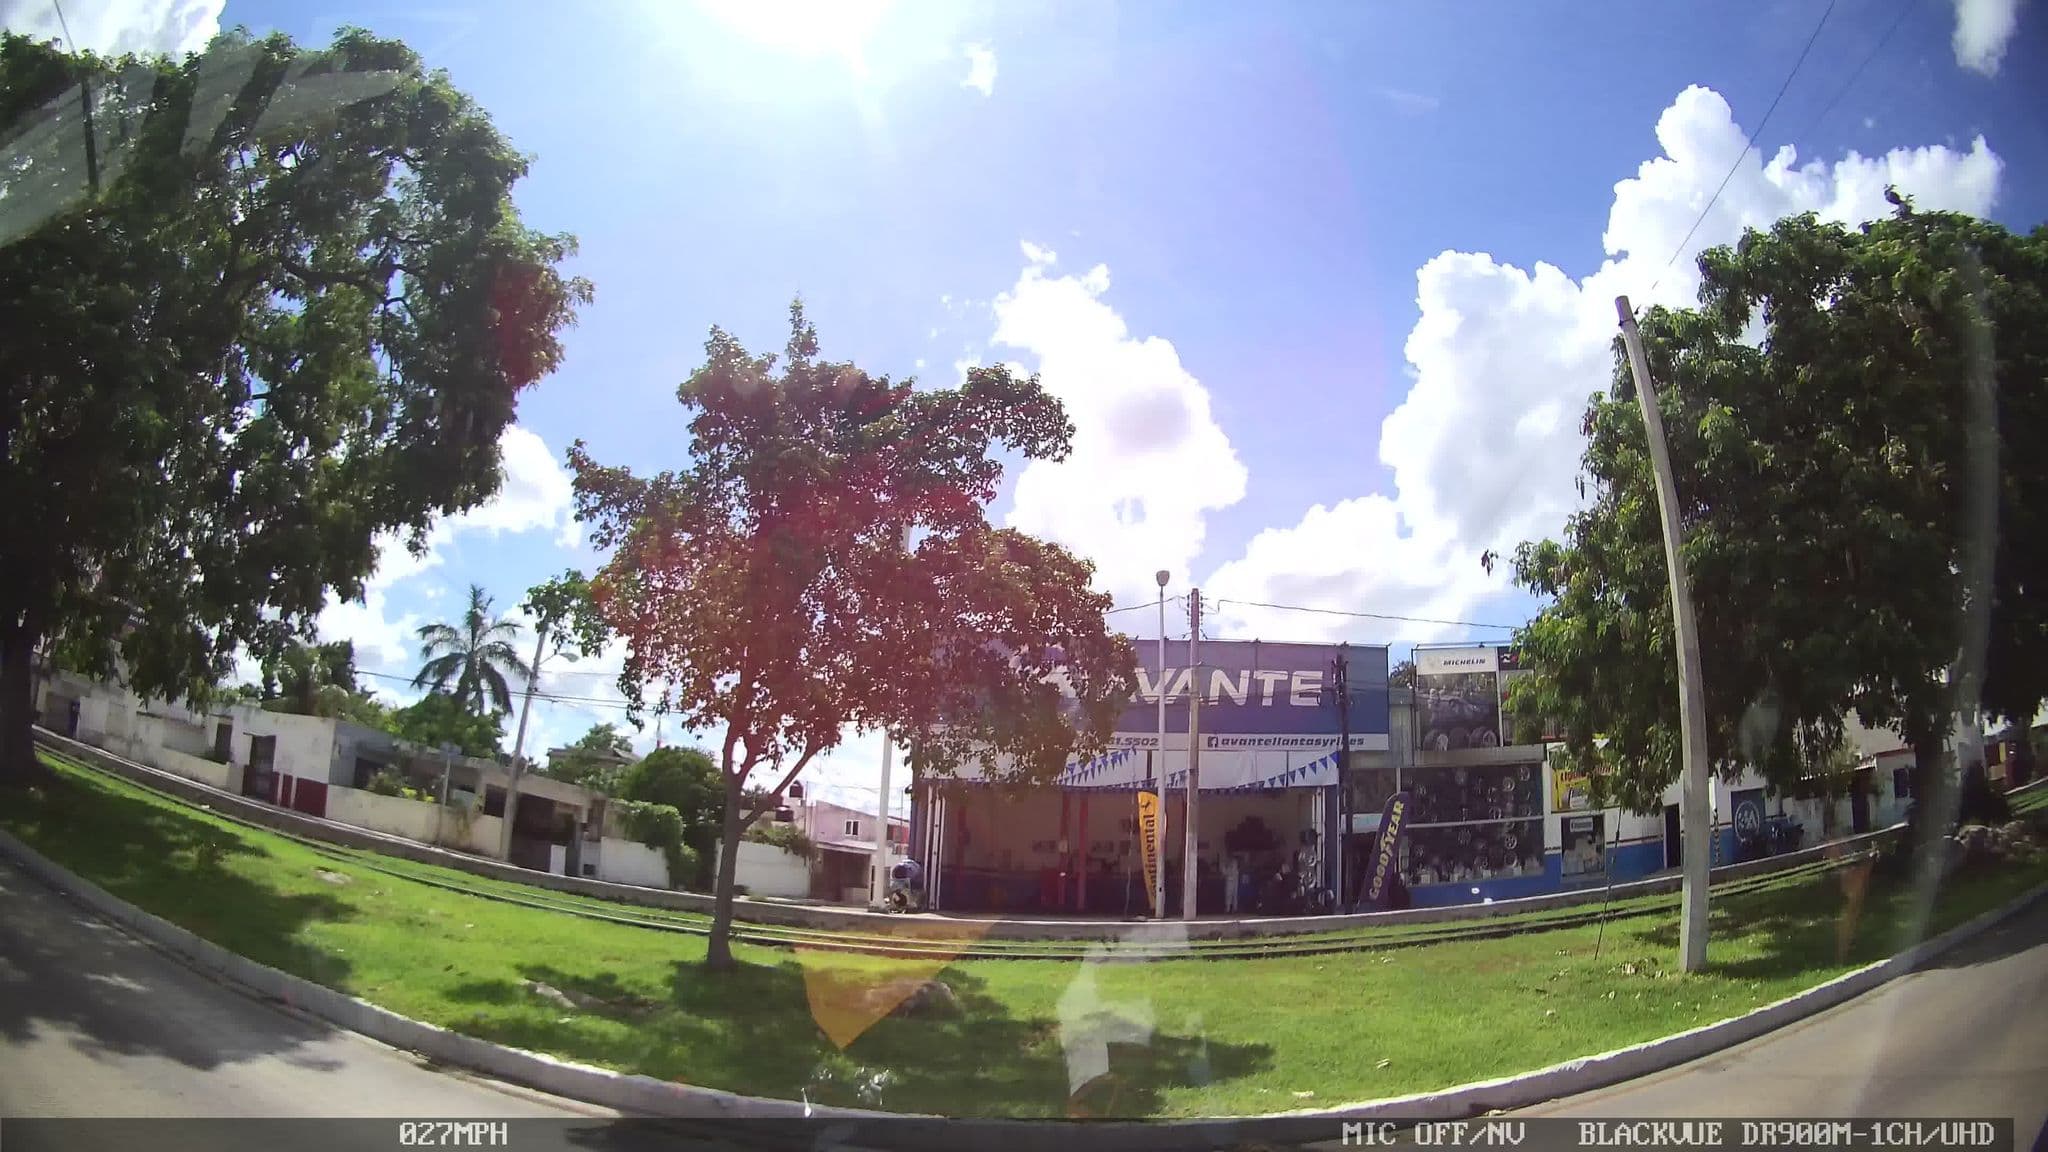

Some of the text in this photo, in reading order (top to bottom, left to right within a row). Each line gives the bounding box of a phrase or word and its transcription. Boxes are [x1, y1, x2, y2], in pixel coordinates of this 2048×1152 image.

[1443, 658, 1486, 666] MICHELIN
[1129, 666, 1323, 706] VANTE
[1221, 736, 1364, 747] avantellantasyries
[1369, 800, 1404, 900] GOODYEAR
